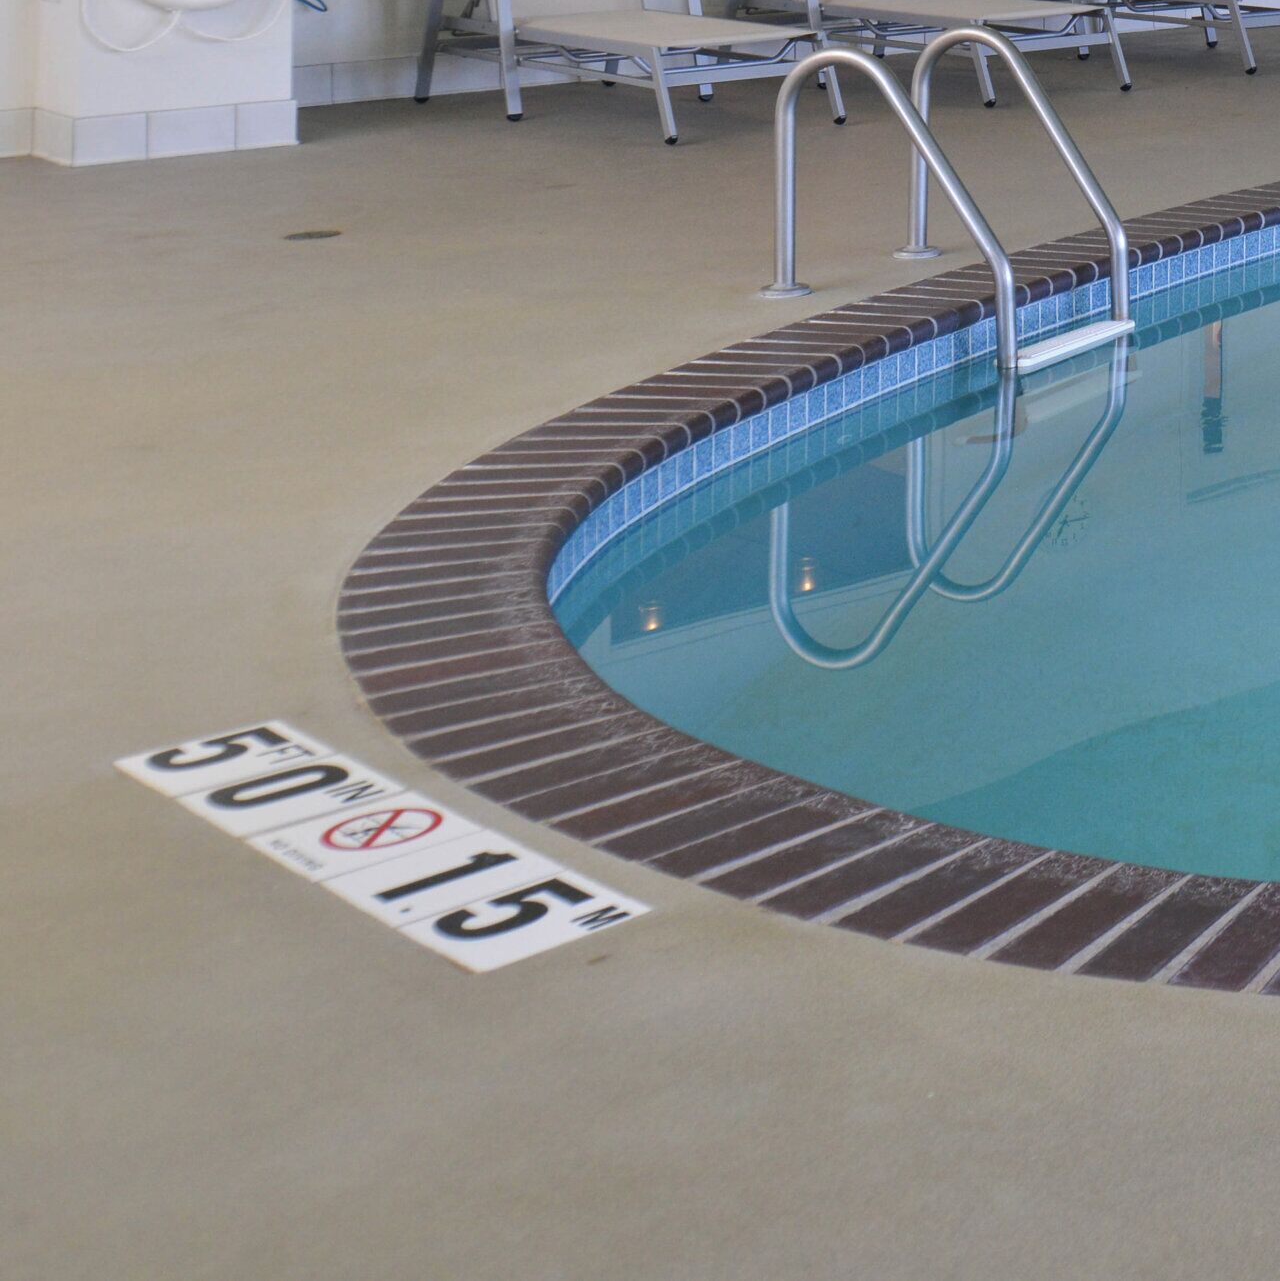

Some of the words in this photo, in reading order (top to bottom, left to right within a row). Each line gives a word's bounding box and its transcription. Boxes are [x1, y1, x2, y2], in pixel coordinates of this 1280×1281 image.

[149, 726, 290, 770] 5
[255, 743, 317, 766] FT
[207, 764, 350, 808] 0
[323, 779, 386, 804] IN
[568, 905, 632, 931] M
